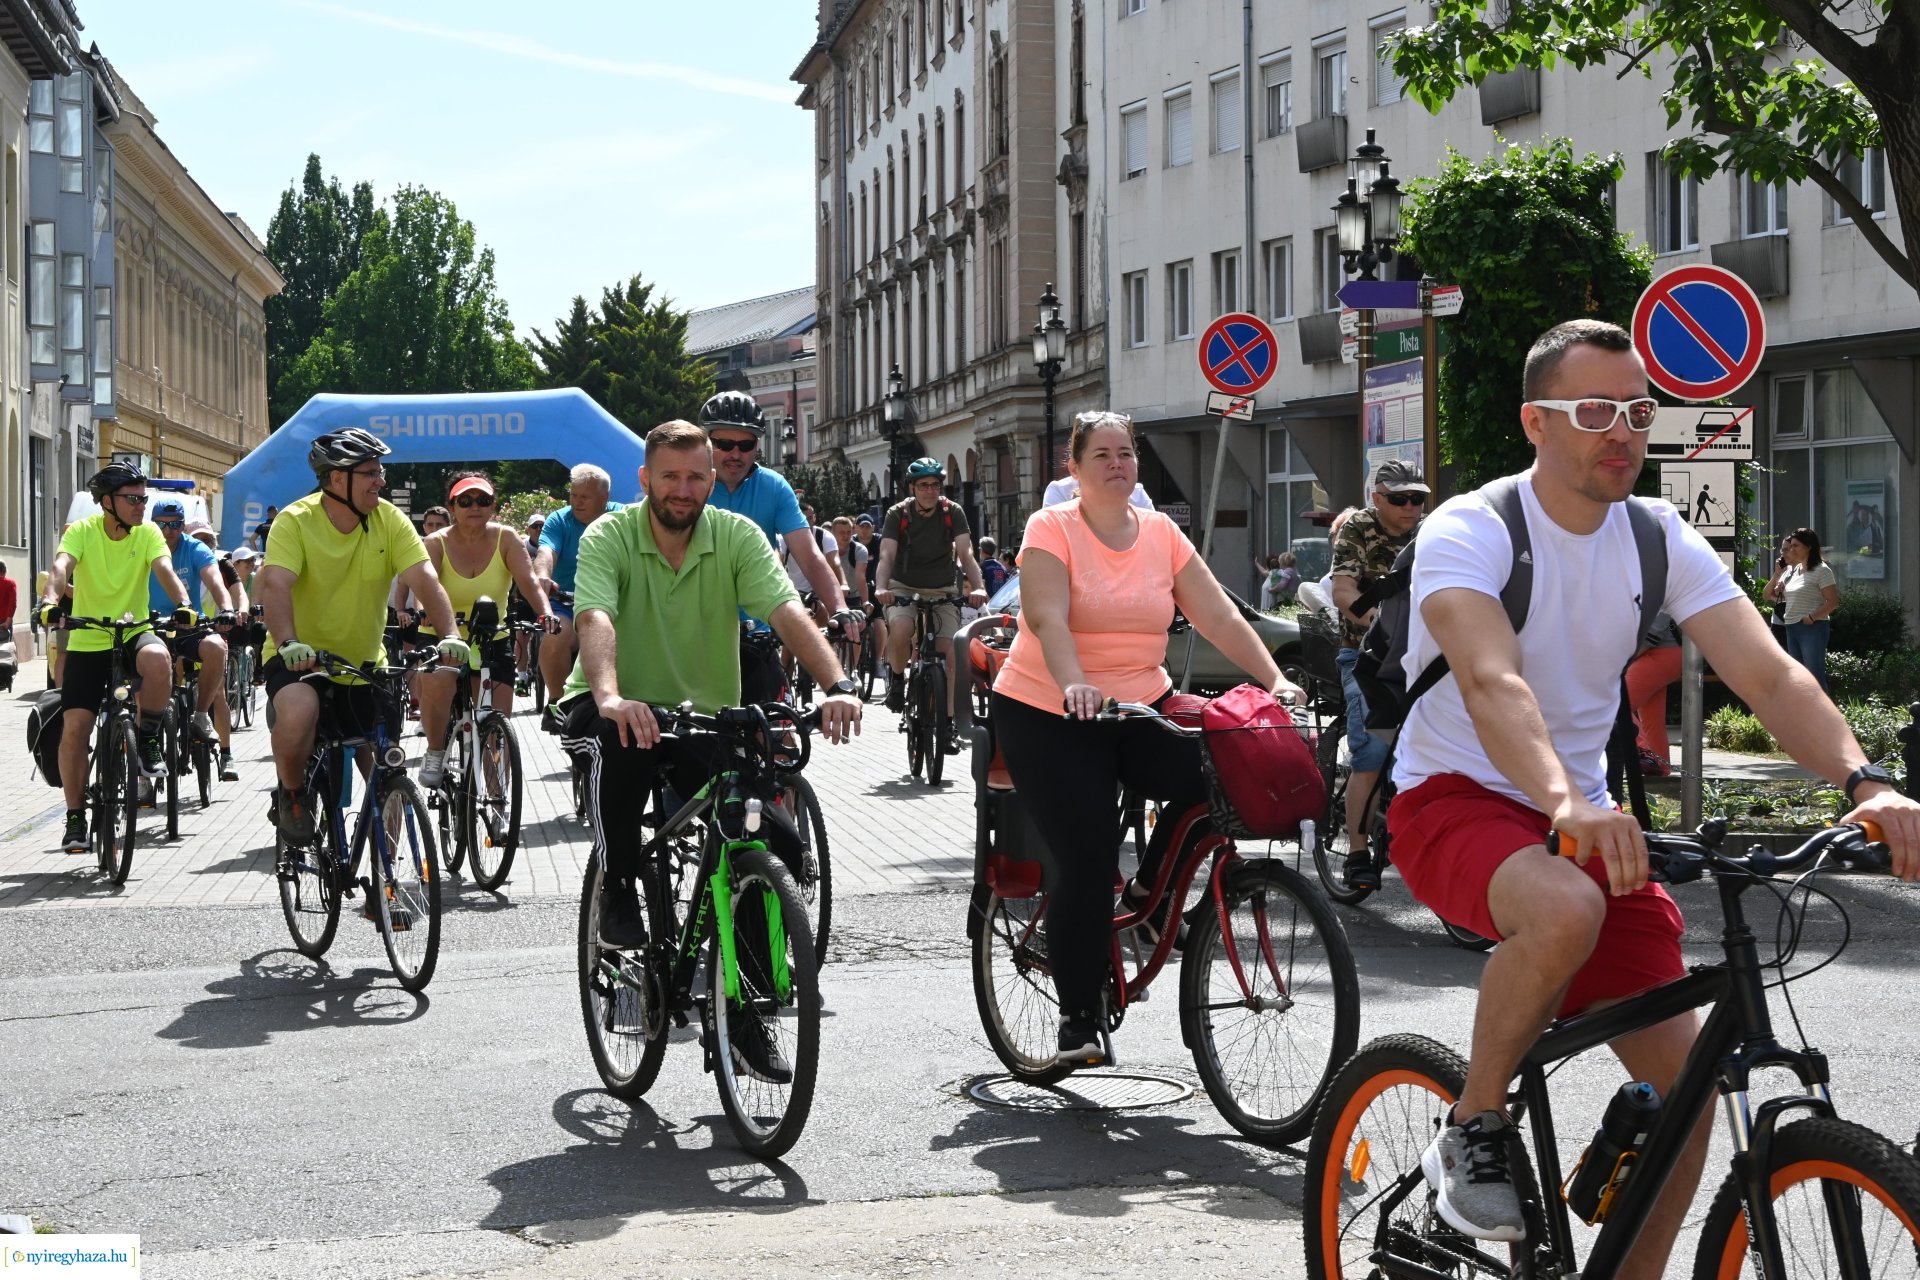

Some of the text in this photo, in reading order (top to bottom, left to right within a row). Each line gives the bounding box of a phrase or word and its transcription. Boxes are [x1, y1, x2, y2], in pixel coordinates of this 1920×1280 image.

[1400, 331, 1419, 353] Posta
[368, 412, 525, 437] SHIMANO
[687, 881, 712, 958] X-FACT
